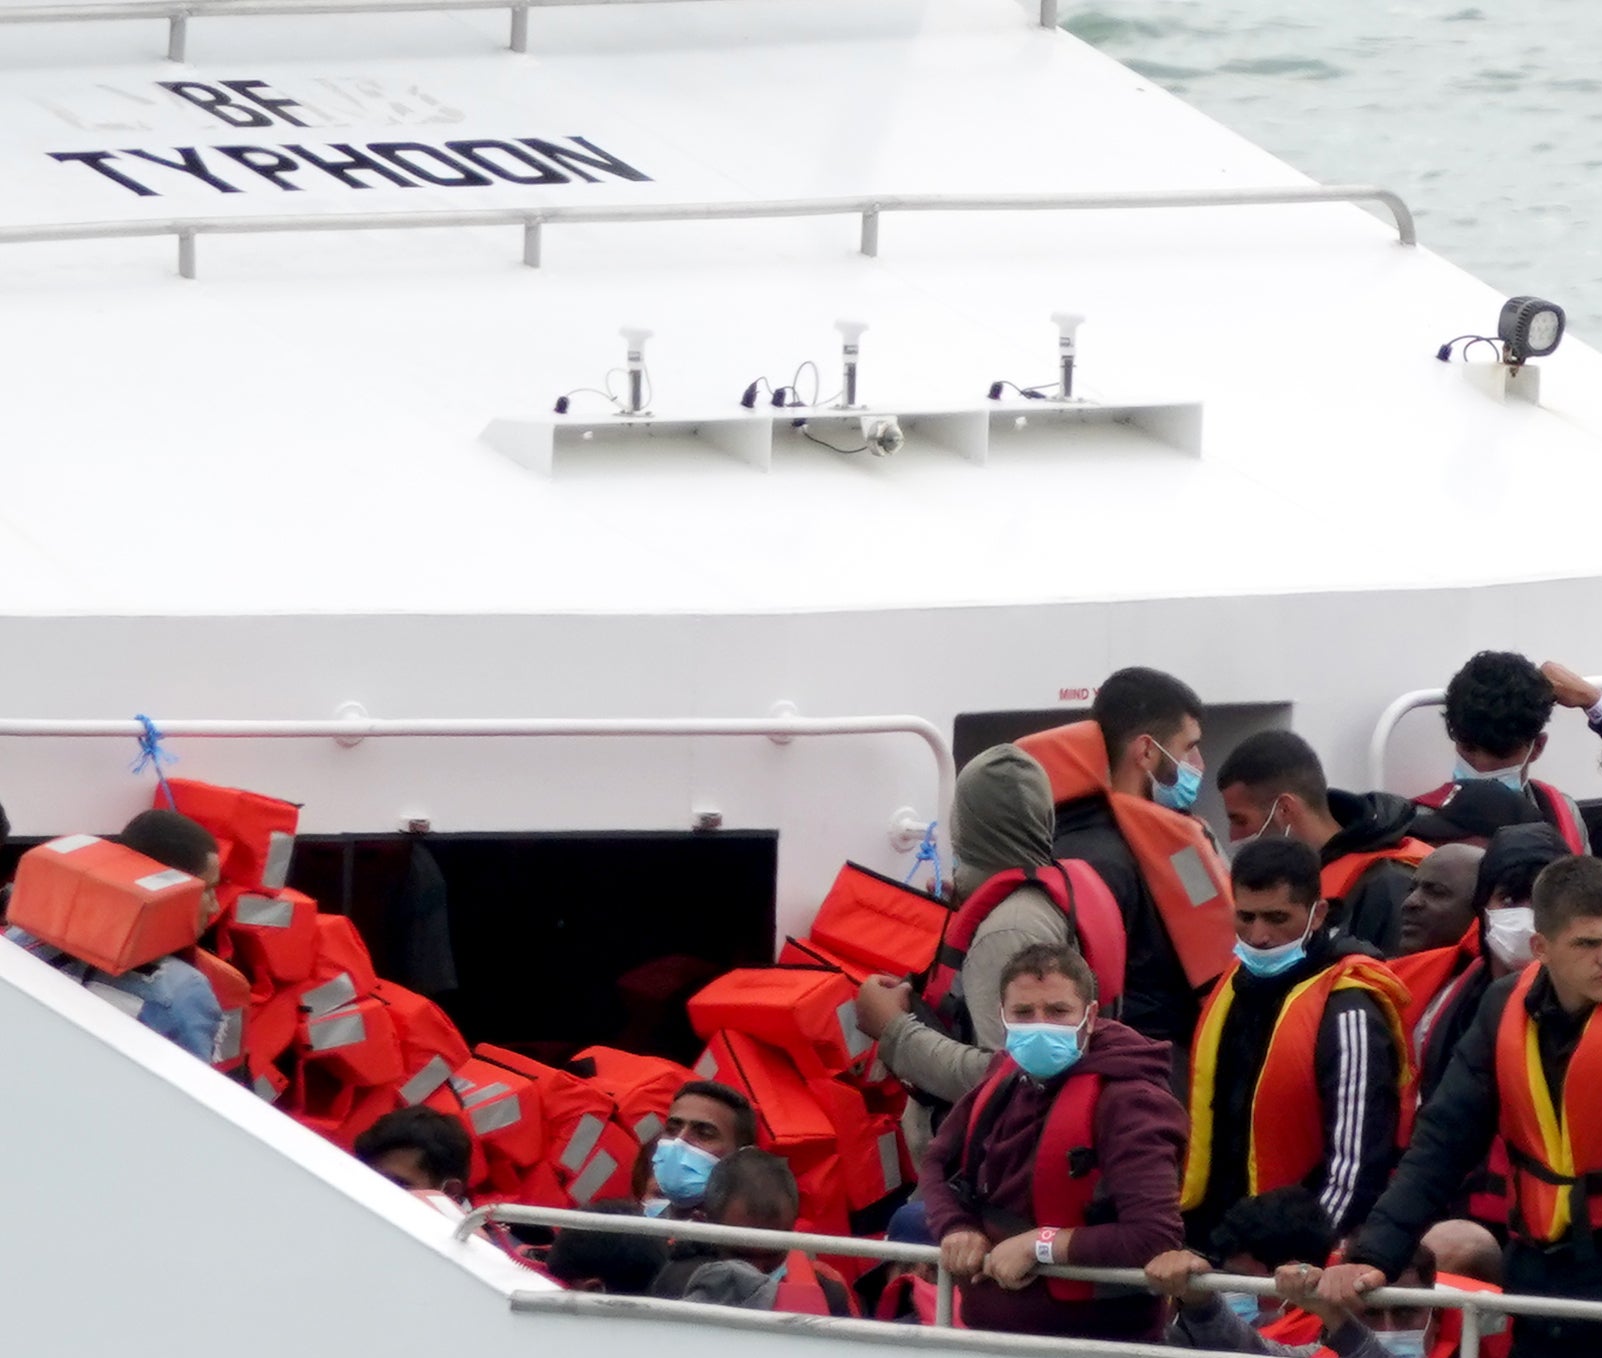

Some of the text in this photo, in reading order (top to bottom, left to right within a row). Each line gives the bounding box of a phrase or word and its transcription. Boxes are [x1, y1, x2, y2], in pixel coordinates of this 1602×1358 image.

[154, 80, 312, 128] BF
[45, 136, 654, 196] TYPHOON
[1059, 687, 1090, 701] MIND
